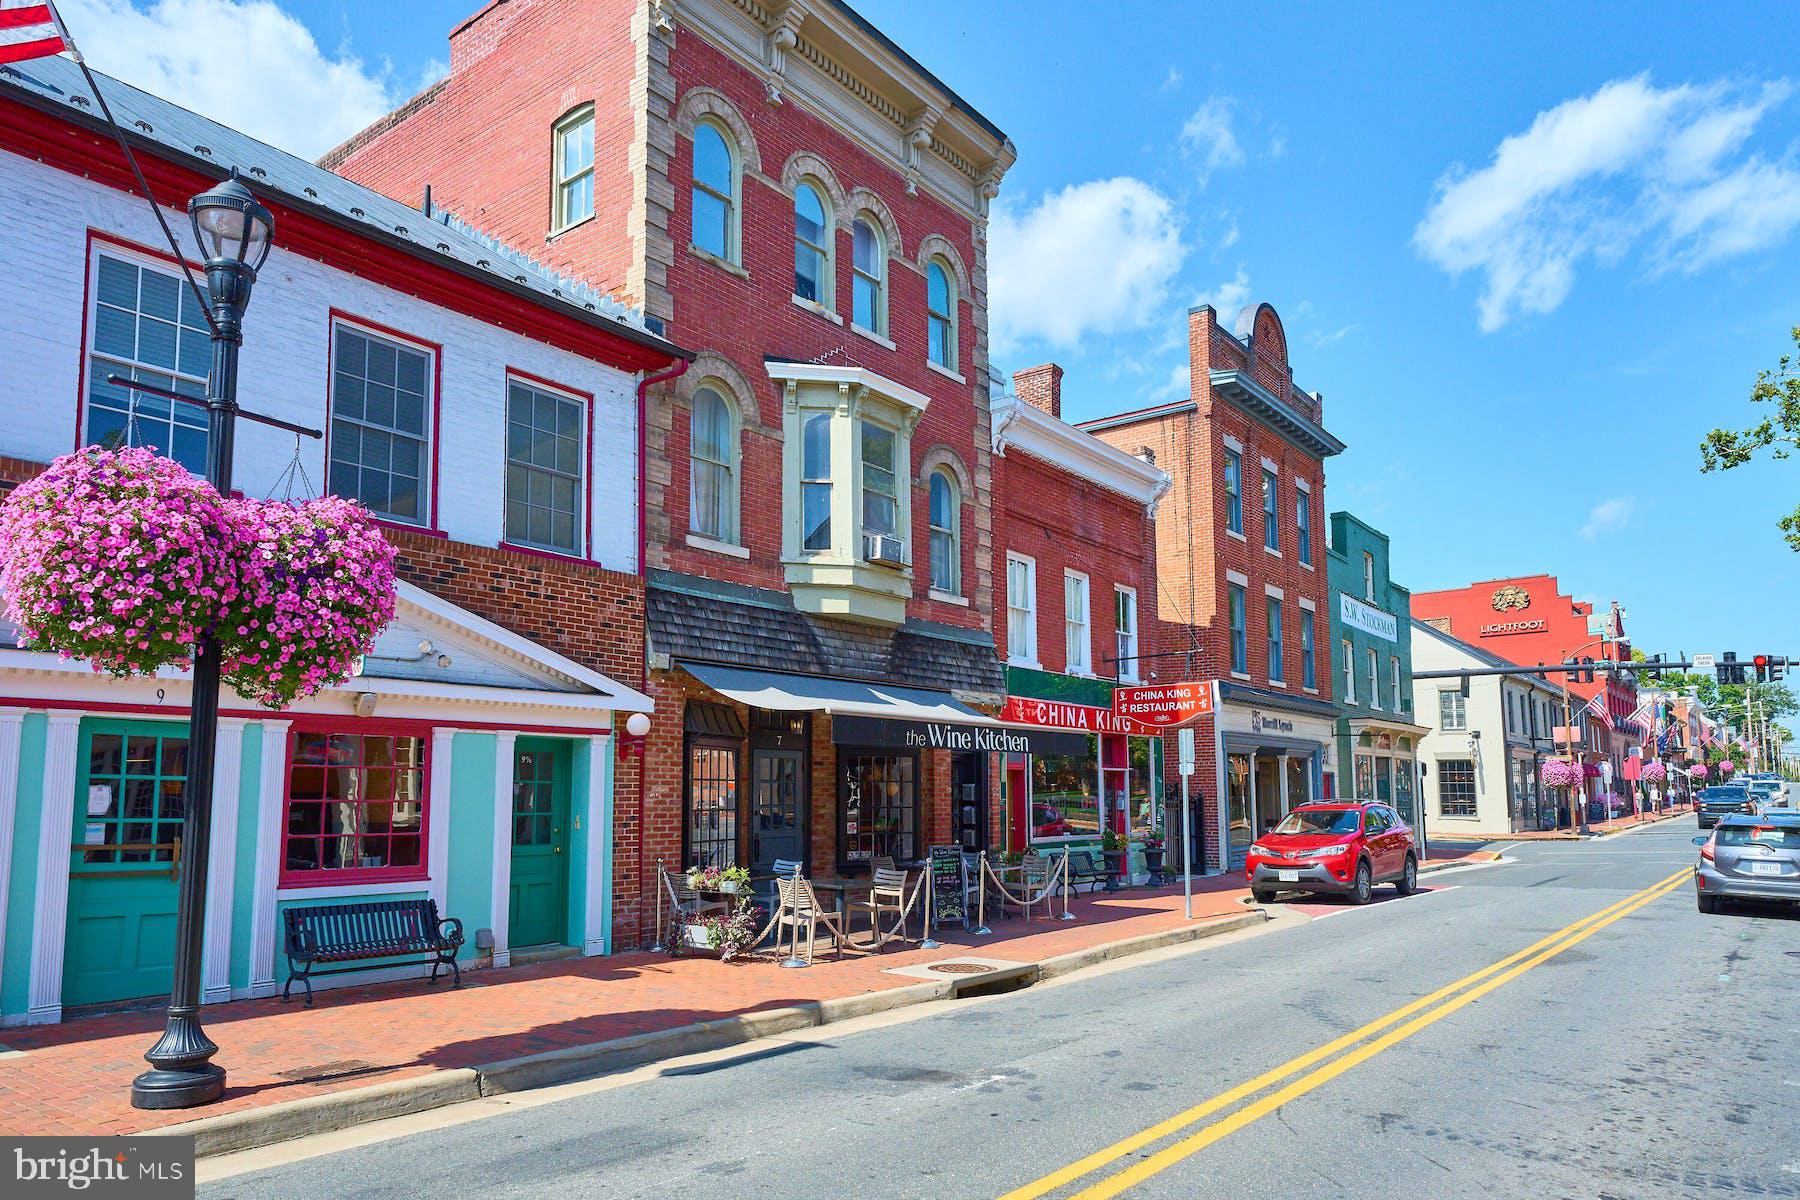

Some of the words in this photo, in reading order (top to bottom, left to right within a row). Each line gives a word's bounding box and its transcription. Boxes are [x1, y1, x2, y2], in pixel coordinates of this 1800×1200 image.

[1345, 600, 1360, 623] S.W.
[1480, 620, 1545, 634] LIGHTFOOT
[156, 688, 165, 704] 9
[1133, 690, 1165, 701] CHINA
[1166, 688, 1192, 699] KING
[1130, 701, 1196, 713] RESTAURANT
[1036, 703, 1088, 728] CHINA
[1096, 711, 1131, 732] KING
[776, 735, 783, 746] 7
[906, 729, 926, 746] the
[927, 723, 971, 749] Wine
[975, 727, 1029, 752] Kitchen
